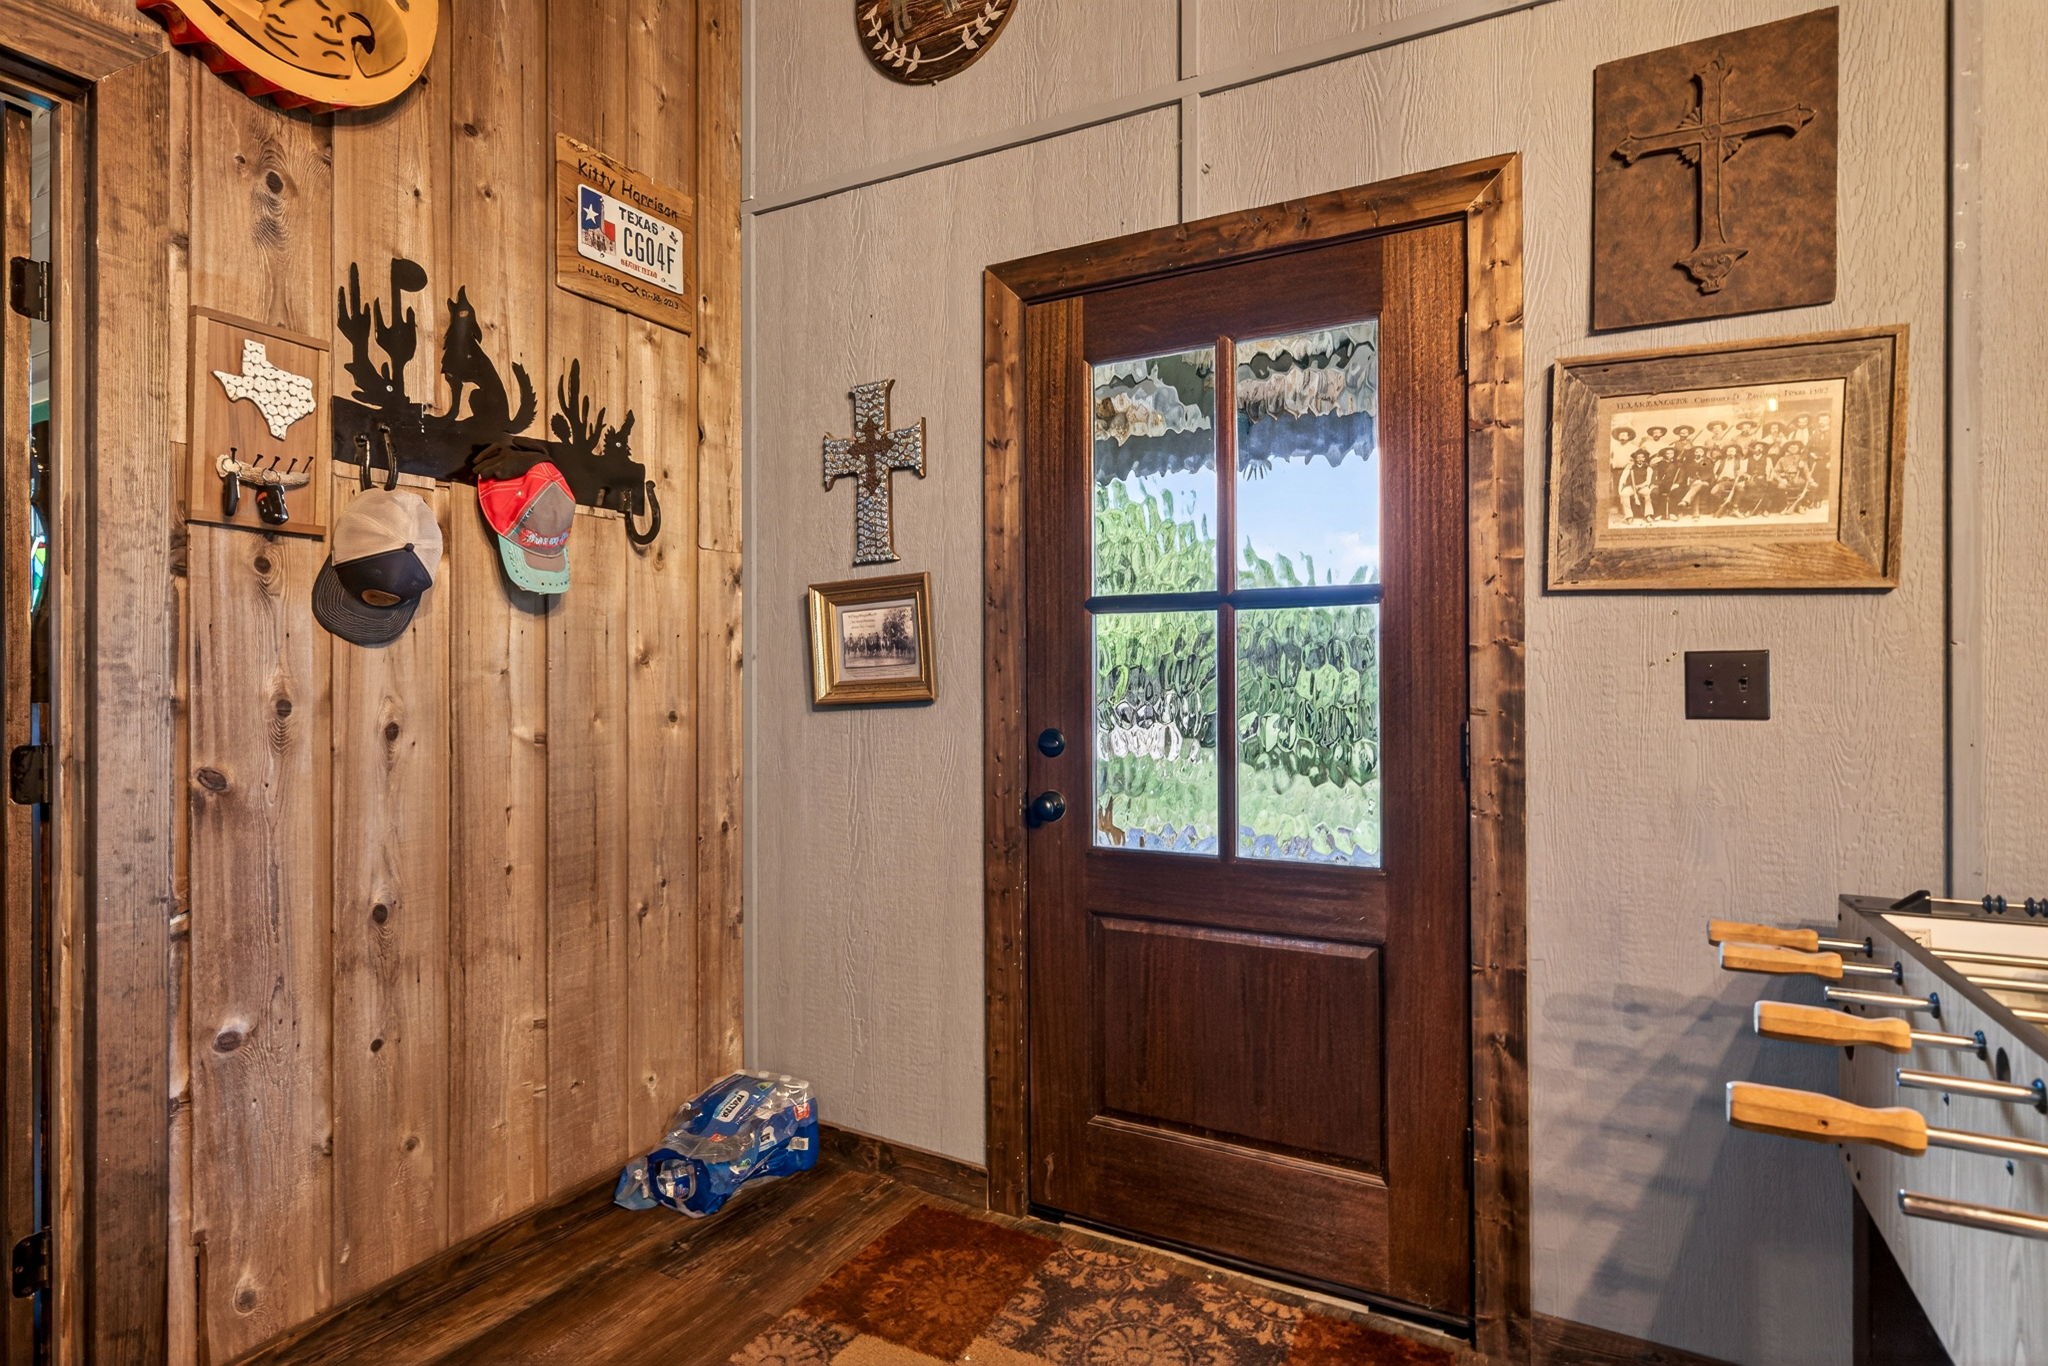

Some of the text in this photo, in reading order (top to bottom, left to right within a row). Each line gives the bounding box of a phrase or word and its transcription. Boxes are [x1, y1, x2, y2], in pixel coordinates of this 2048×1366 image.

[578, 158, 679, 222] Kitty Harrison
[618, 206, 659, 236] TEXAS
